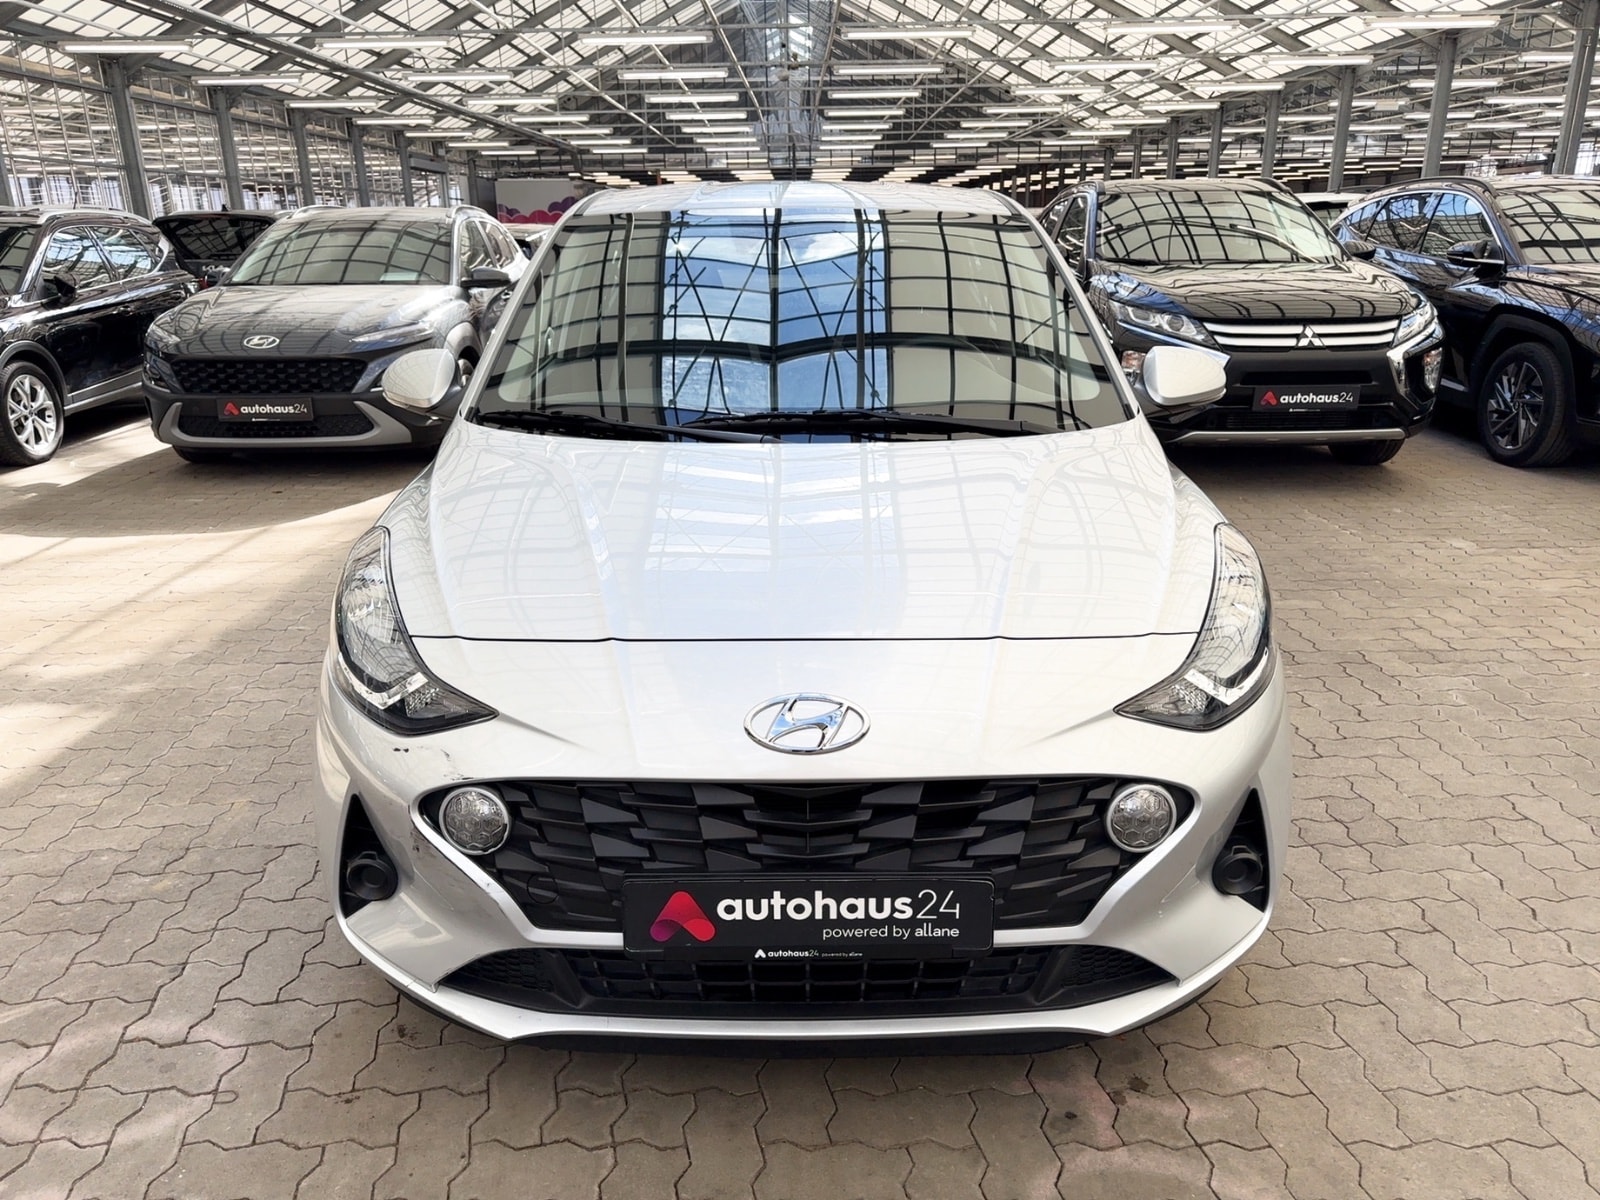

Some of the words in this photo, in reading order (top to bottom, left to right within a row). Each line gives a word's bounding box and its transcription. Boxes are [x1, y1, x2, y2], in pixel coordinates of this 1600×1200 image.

[1280, 392, 1353, 403] autohaus24
[240, 404, 307, 414] autohaus24
[717, 889, 960, 920] autohaus24
[823, 925, 888, 940] powered
[893, 925, 911, 940] by
[915, 922, 960, 937] allane
